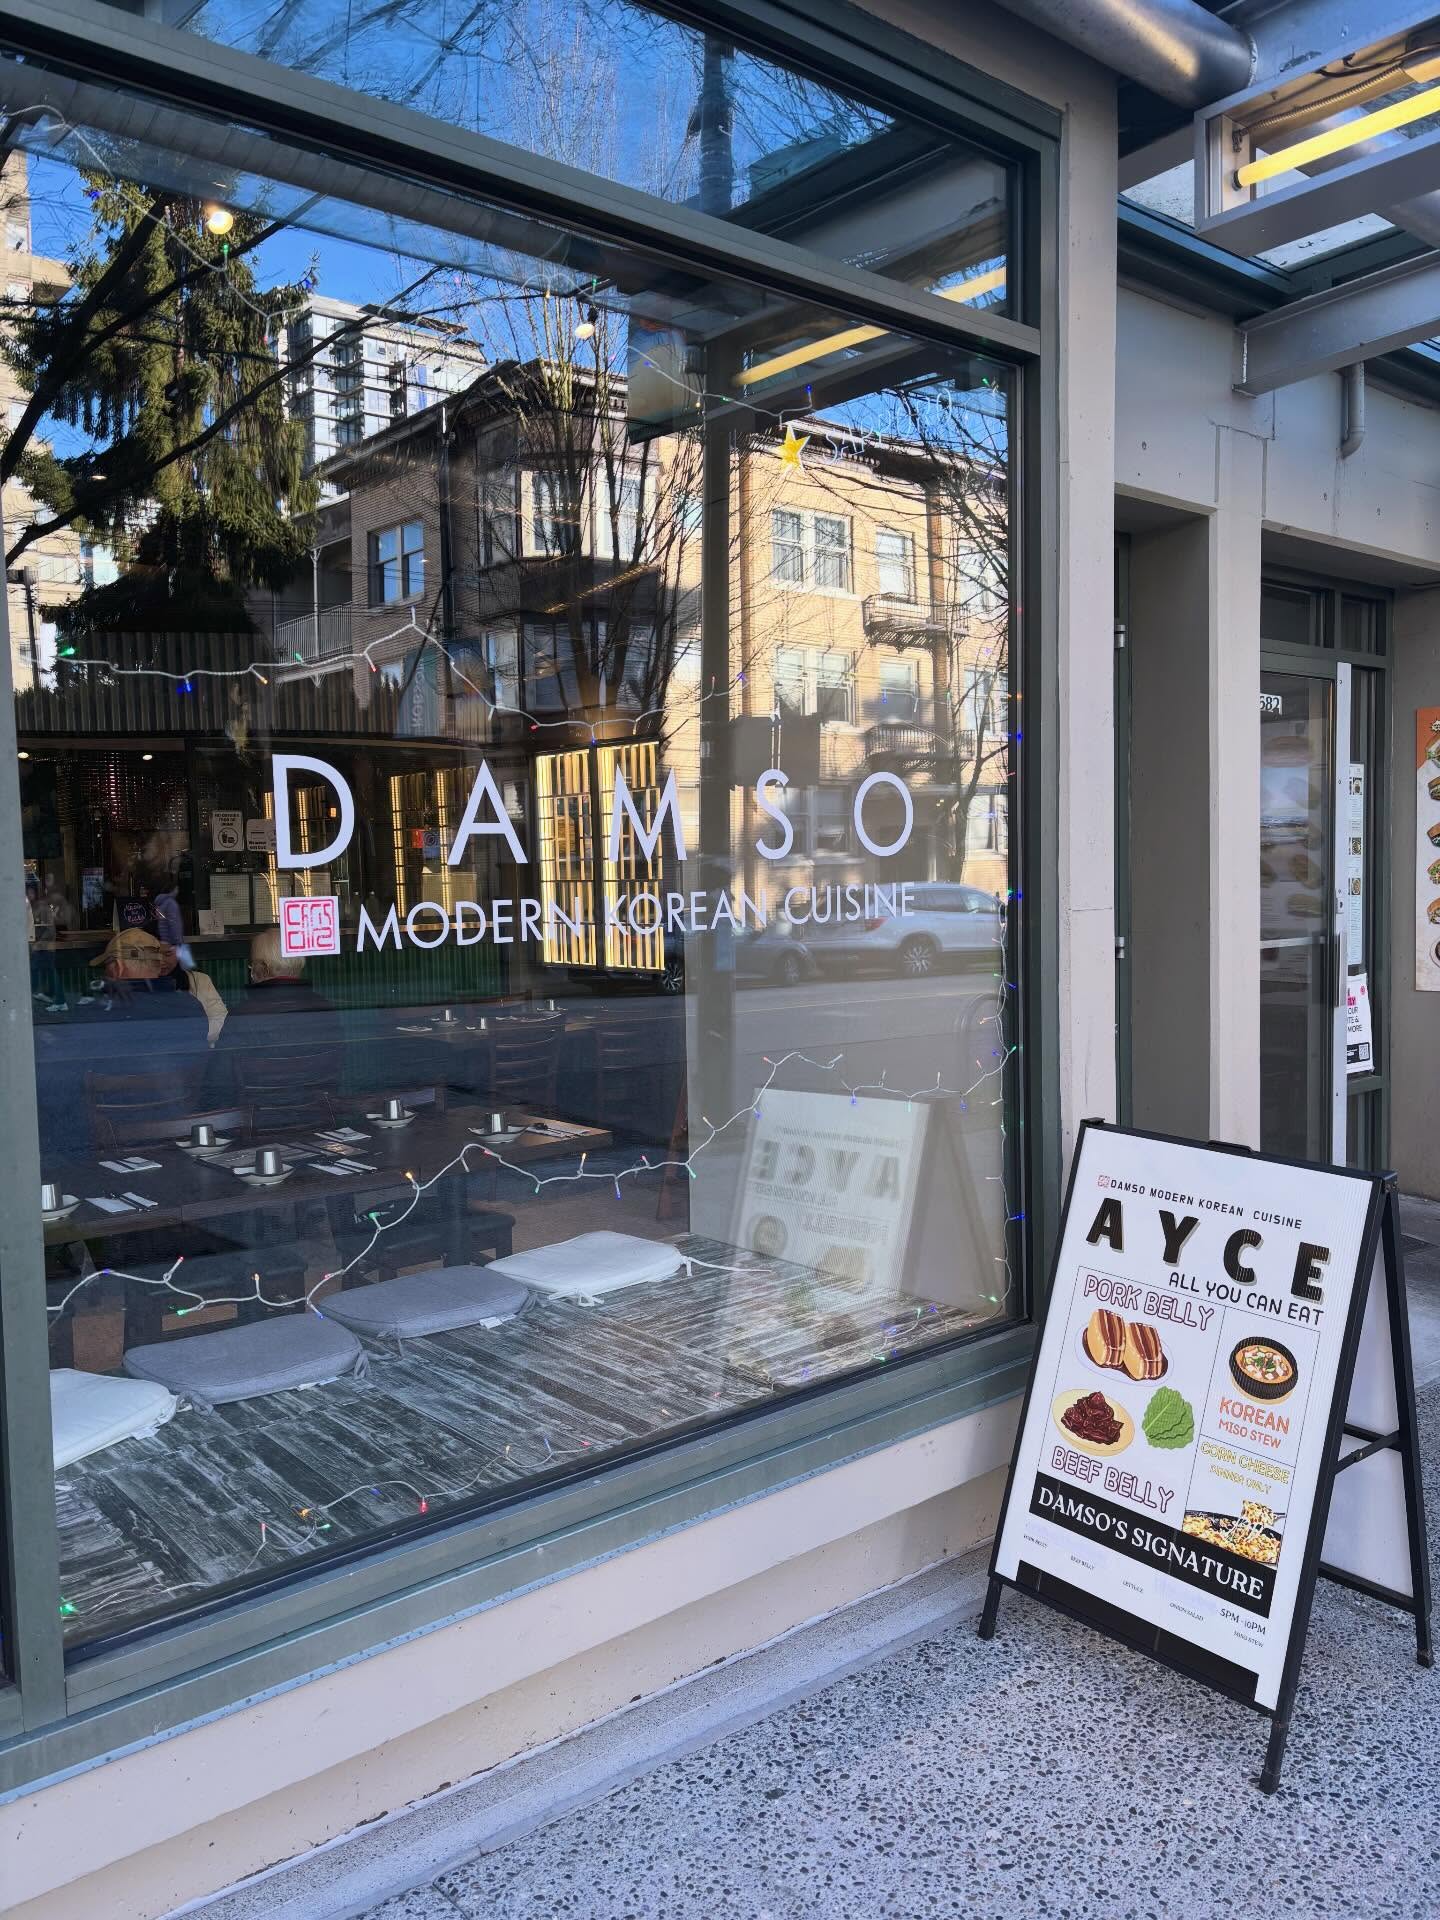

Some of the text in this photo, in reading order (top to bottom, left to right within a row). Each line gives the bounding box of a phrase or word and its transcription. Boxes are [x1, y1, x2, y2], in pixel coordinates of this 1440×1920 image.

[272, 754, 914, 868] DAMSO
[356, 881, 915, 952] MODERN KOREAN CUISINE
[1110, 1179, 1146, 1195] DAMSO
[1150, 1188, 1194, 1206] MODERN
[1198, 1199, 1244, 1217] KOREAN
[1253, 1210, 1303, 1230] CUISINE
[1086, 1197, 1332, 1304] AYCE
[1084, 1275, 1215, 1332] PORK BELLY
[1169, 1272, 1325, 1326] ALL YOU CAN EAT
[1218, 1418, 1282, 1449] MISO STEW
[1219, 1396, 1291, 1435] KOREAN
[1052, 1445, 1175, 1514] BEEF BELLY
[1200, 1441, 1291, 1485] CORN CHEESE
[1037, 1486, 1129, 1541] DAMSO'S
[1131, 1527, 1265, 1600] SIGNATURE
